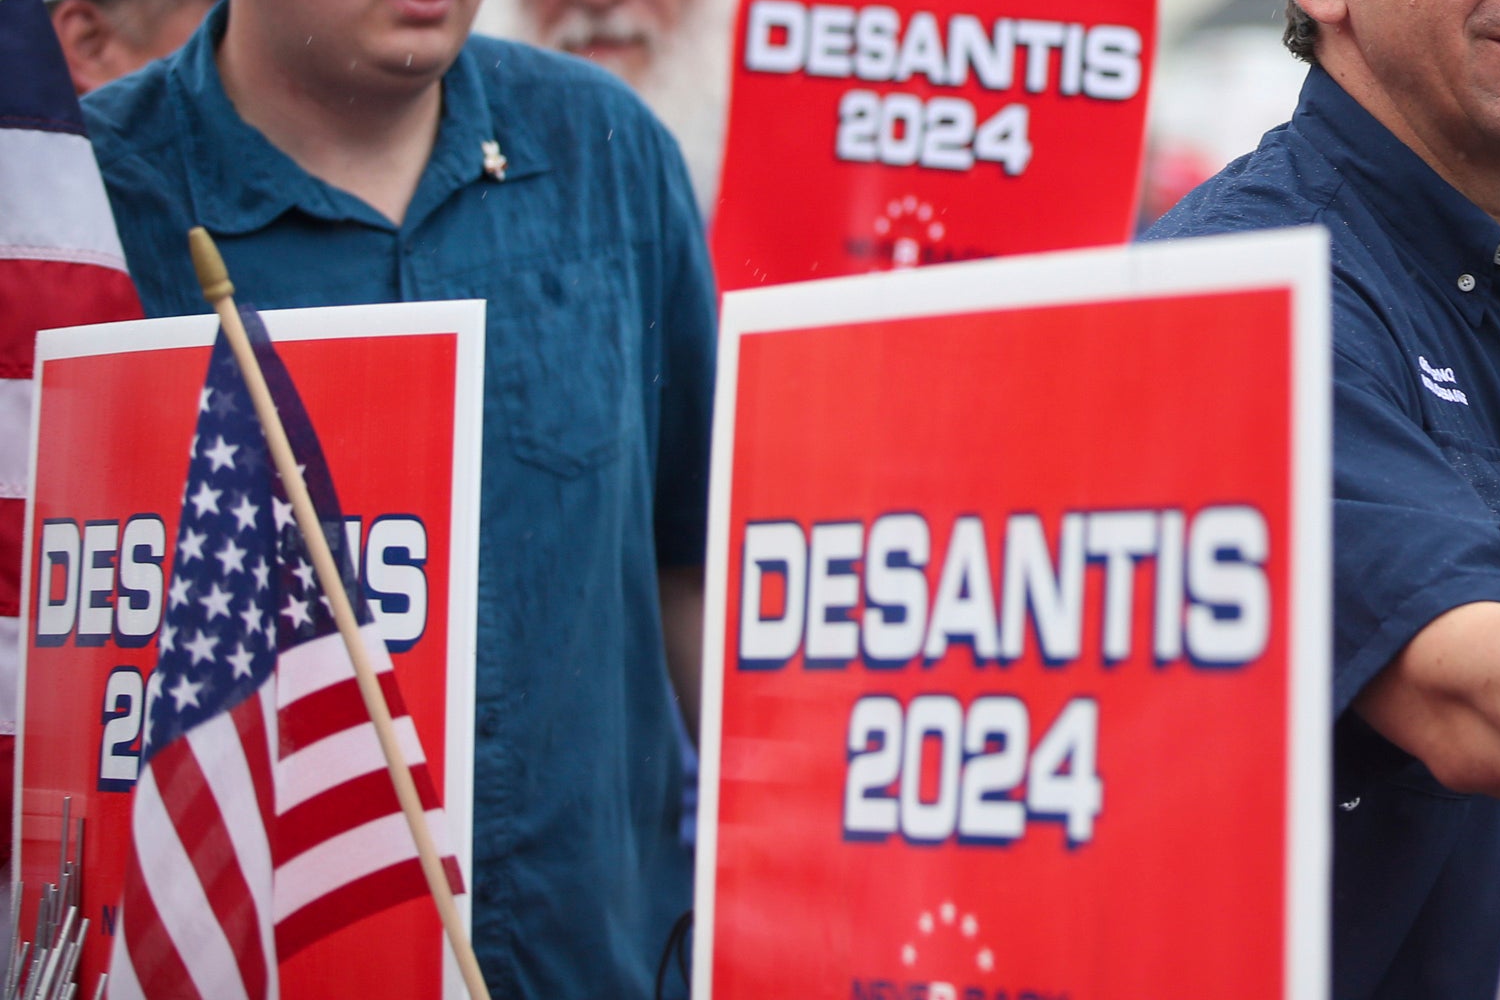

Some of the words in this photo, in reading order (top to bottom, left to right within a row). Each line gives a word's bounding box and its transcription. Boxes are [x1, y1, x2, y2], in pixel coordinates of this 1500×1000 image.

[836, 89, 1032, 177] 2024
[35, 512, 428, 654] DESS
[738, 503, 1272, 673] DESANTIS
[842, 693, 1105, 852] 2024
